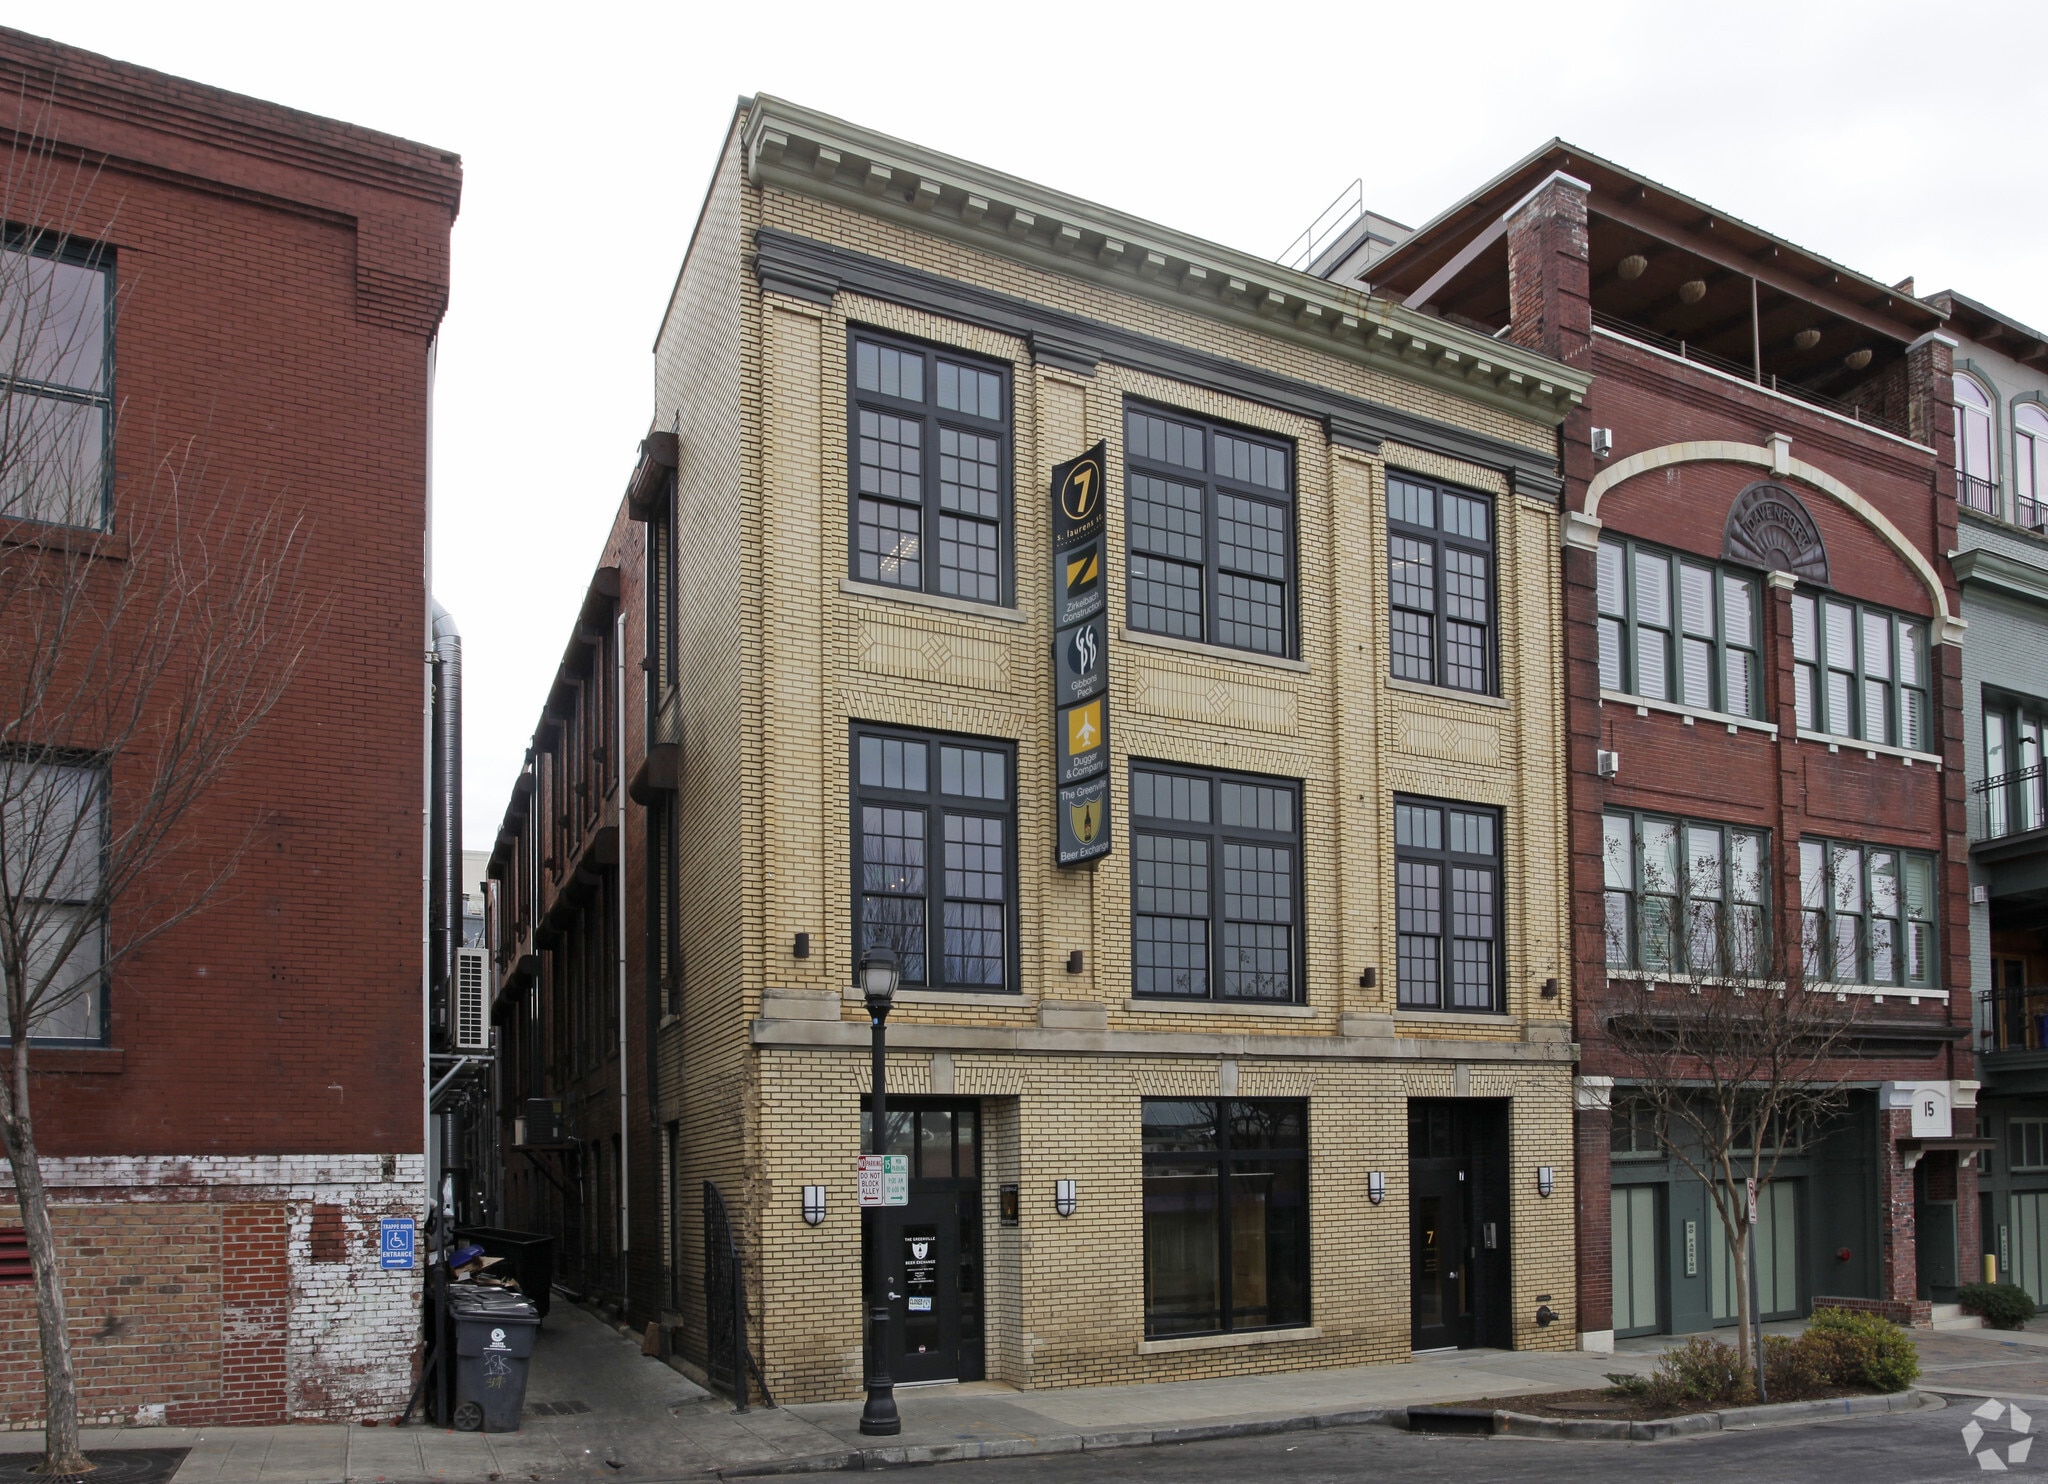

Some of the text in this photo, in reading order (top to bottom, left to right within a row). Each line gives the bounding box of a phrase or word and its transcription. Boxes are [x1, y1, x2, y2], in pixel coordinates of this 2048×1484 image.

[1074, 468, 1092, 513] 7
[1056, 514, 1104, 541] s. laurens st.
[1746, 504, 1811, 548] DAVENPORT
[1067, 591, 1099, 612] Zirkelbach
[1062, 601, 1102, 623] Construction
[1071, 674, 1097, 691] Gibbons
[1077, 686, 1093, 699] Peck
[1066, 759, 1104, 779] & Company
[1073, 752, 1098, 769] Dugger
[1061, 779, 1107, 801] The Greenville
[1061, 841, 1109, 861] Beer Exchange
[1924, 1101, 1934, 1117] 15
[859, 1158, 866, 1169] NO
[885, 1159, 891, 1169] 15
[1426, 1230, 1434, 1244] 7
[1688, 1224, 1694, 1233] NO
